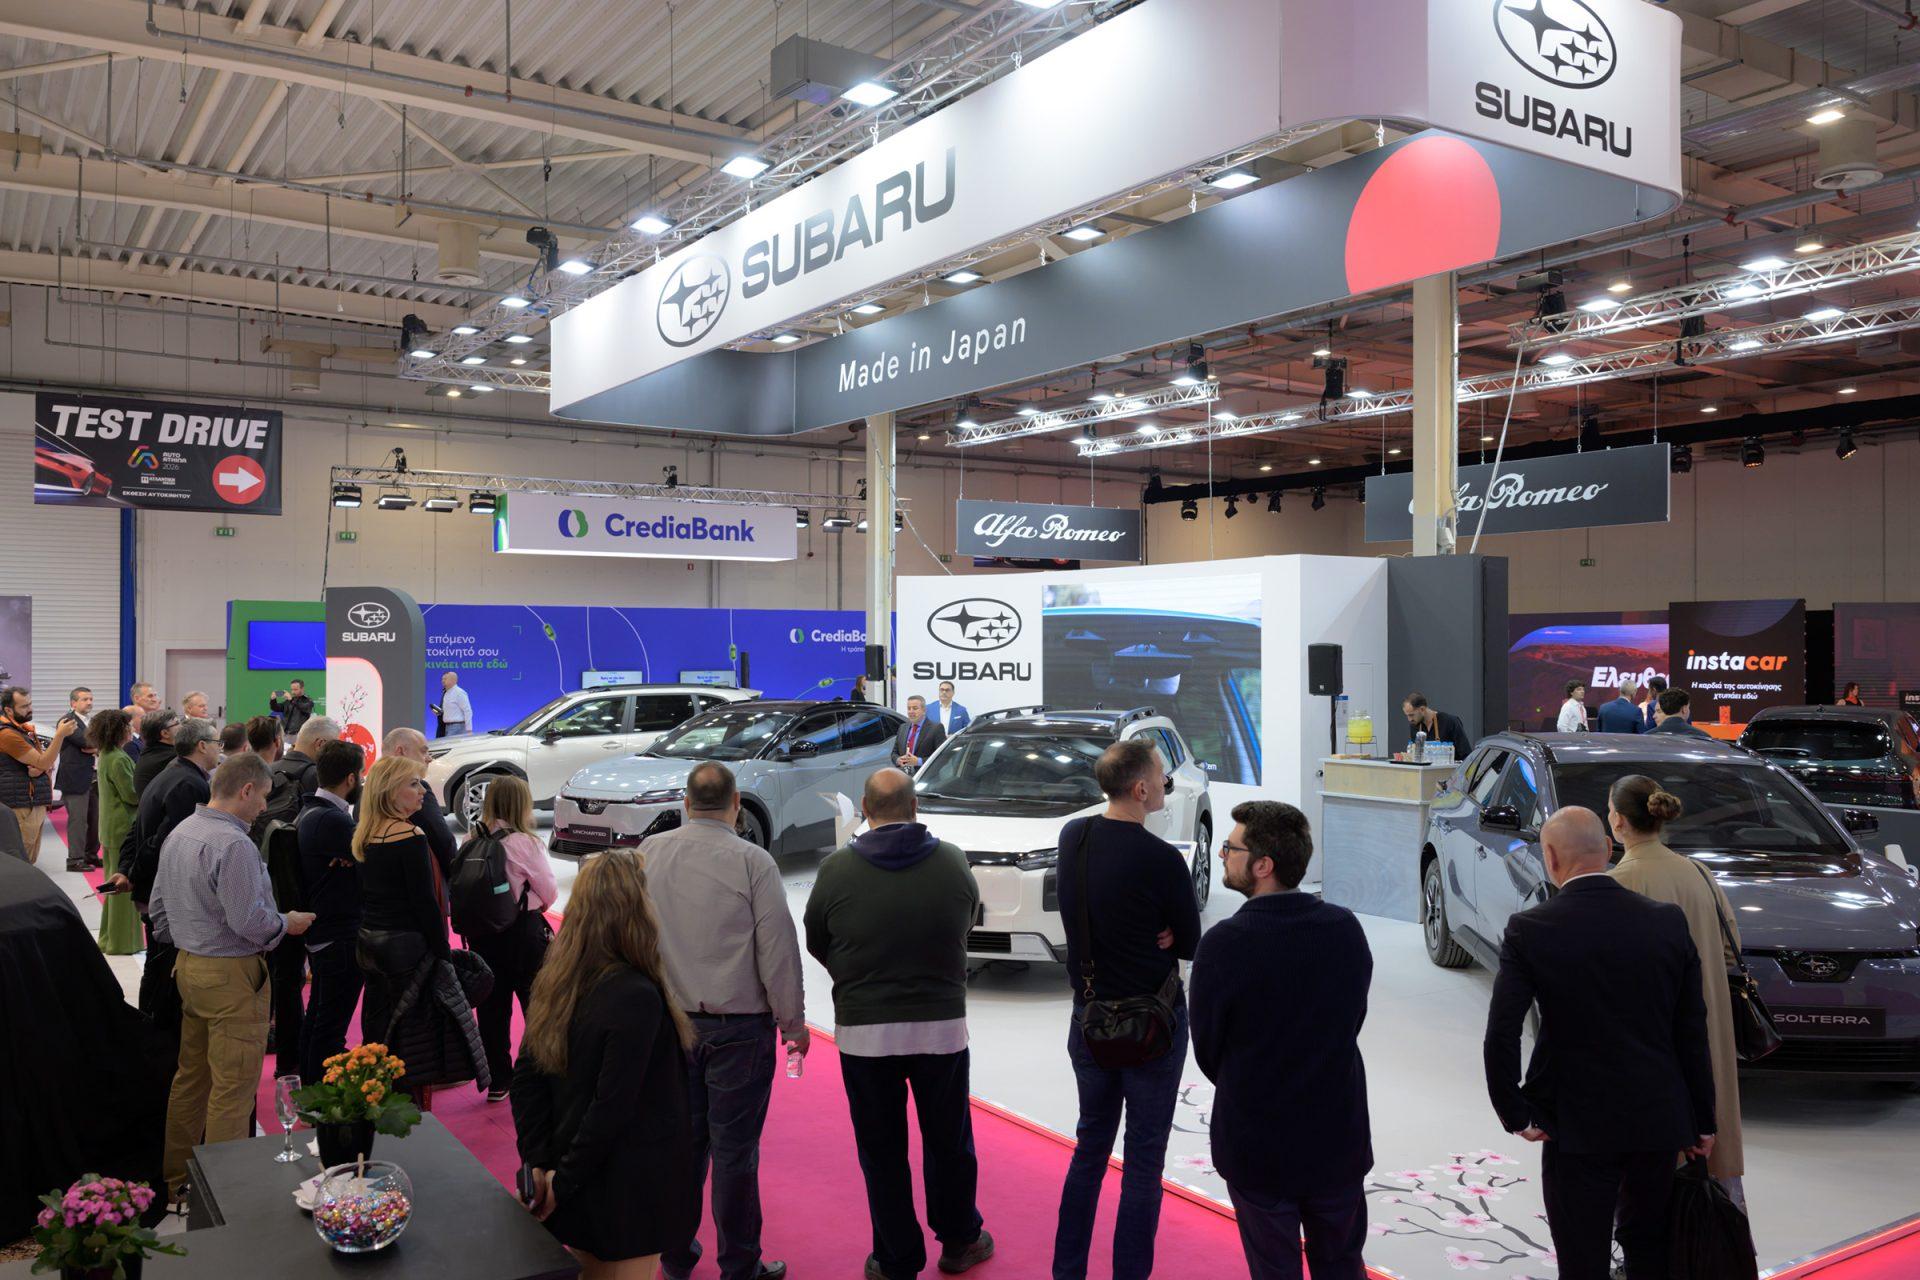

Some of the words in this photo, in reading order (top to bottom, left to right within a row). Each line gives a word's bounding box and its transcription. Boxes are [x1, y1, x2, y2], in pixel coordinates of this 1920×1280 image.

[1475, 81, 1632, 158] SUBARU
[742, 145, 956, 299] SUBARU
[839, 352, 899, 393] Made
[909, 341, 931, 373] in
[942, 316, 1026, 365] Japan
[51, 404, 152, 442] TEST
[158, 413, 268, 450] DRIVE
[1487, 473, 1608, 509] Romeo
[605, 513, 754, 542] CrediaBank
[973, 513, 1038, 548] Alfa
[1039, 513, 1126, 543] Romeo
[342, 631, 396, 642] SUBARU
[428, 633, 476, 646] επόμενο
[461, 659, 483, 669] από
[486, 658, 508, 669] εδώ
[477, 648, 499, 657] σου
[1686, 649, 1788, 671] instacar
[913, 661, 1032, 681] SUBARU
[1698, 682, 1722, 690] καρδιά
[1773, 1013, 1871, 1025] SOLTERRA
